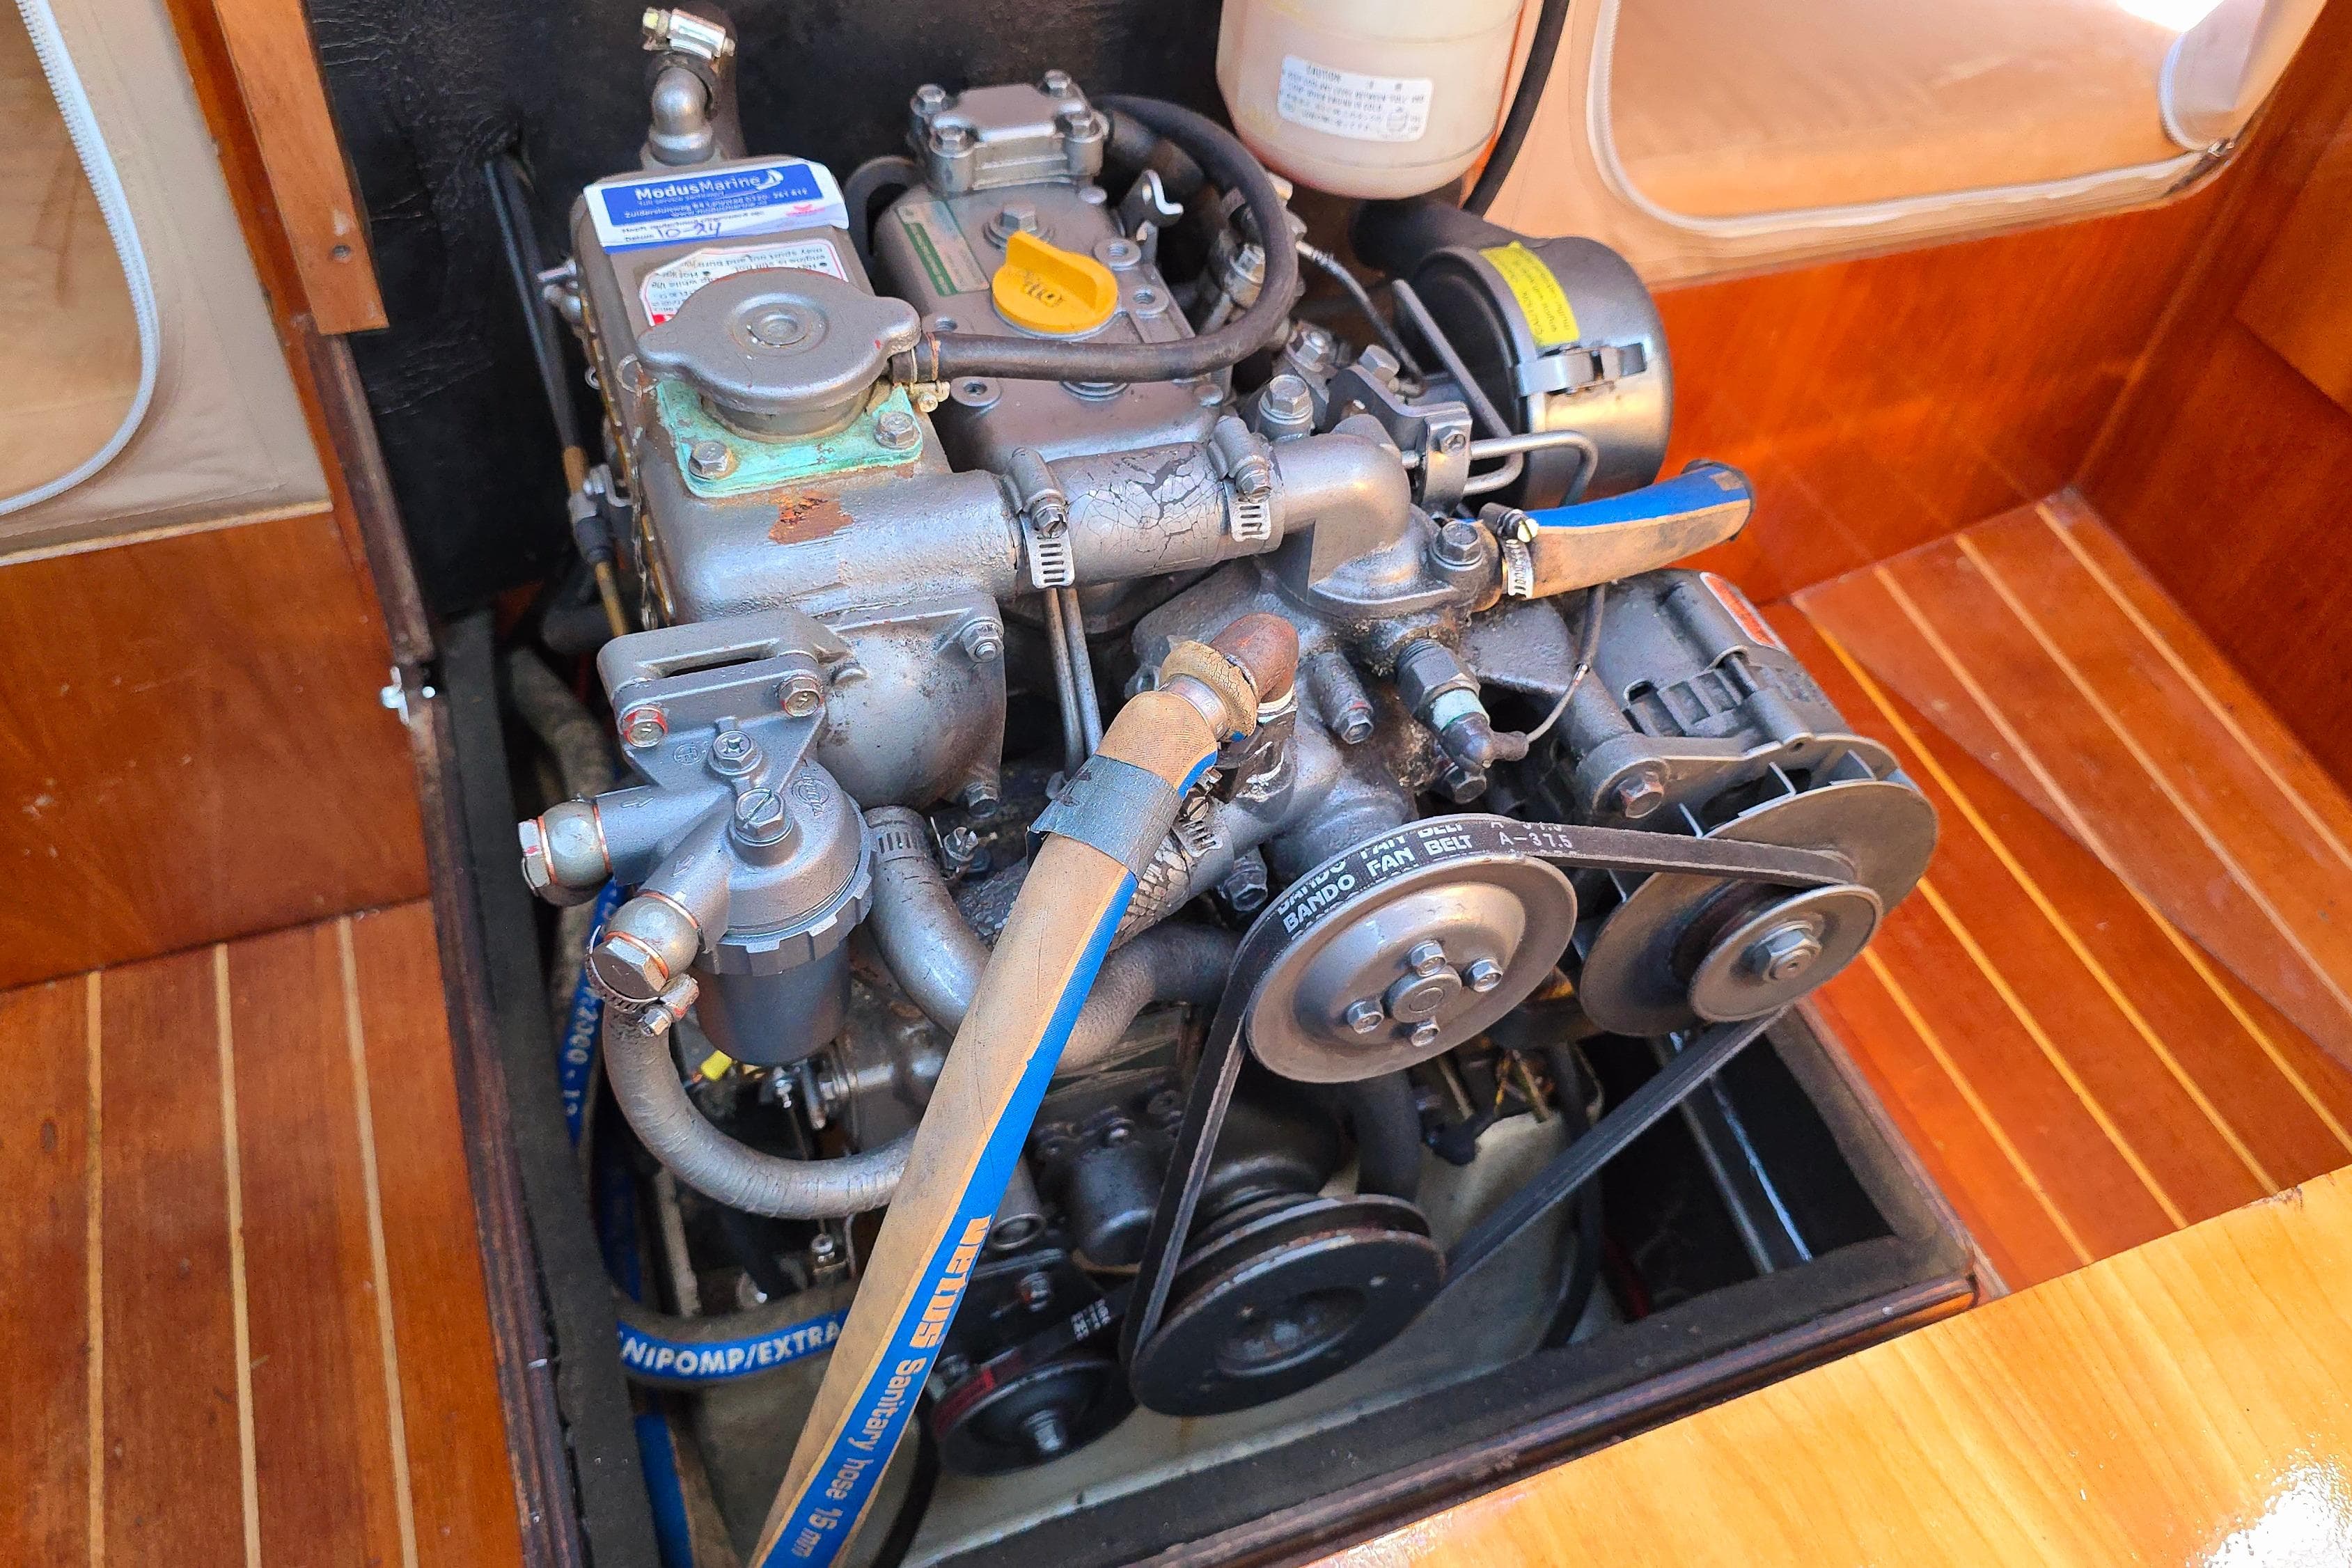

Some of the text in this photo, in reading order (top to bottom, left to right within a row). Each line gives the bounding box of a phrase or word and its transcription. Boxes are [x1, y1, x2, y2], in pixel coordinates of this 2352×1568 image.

[634, 174, 761, 201] ModusMarine
[1283, 874, 1356, 933] BANDO
[1366, 847, 1416, 877] FAN
[1423, 835, 1473, 856] BELT
[618, 1321, 840, 1376] NIPOMP/EXTRA
[847, 1357, 927, 1452] Sanitary
[825, 1457, 875, 1500] hose
